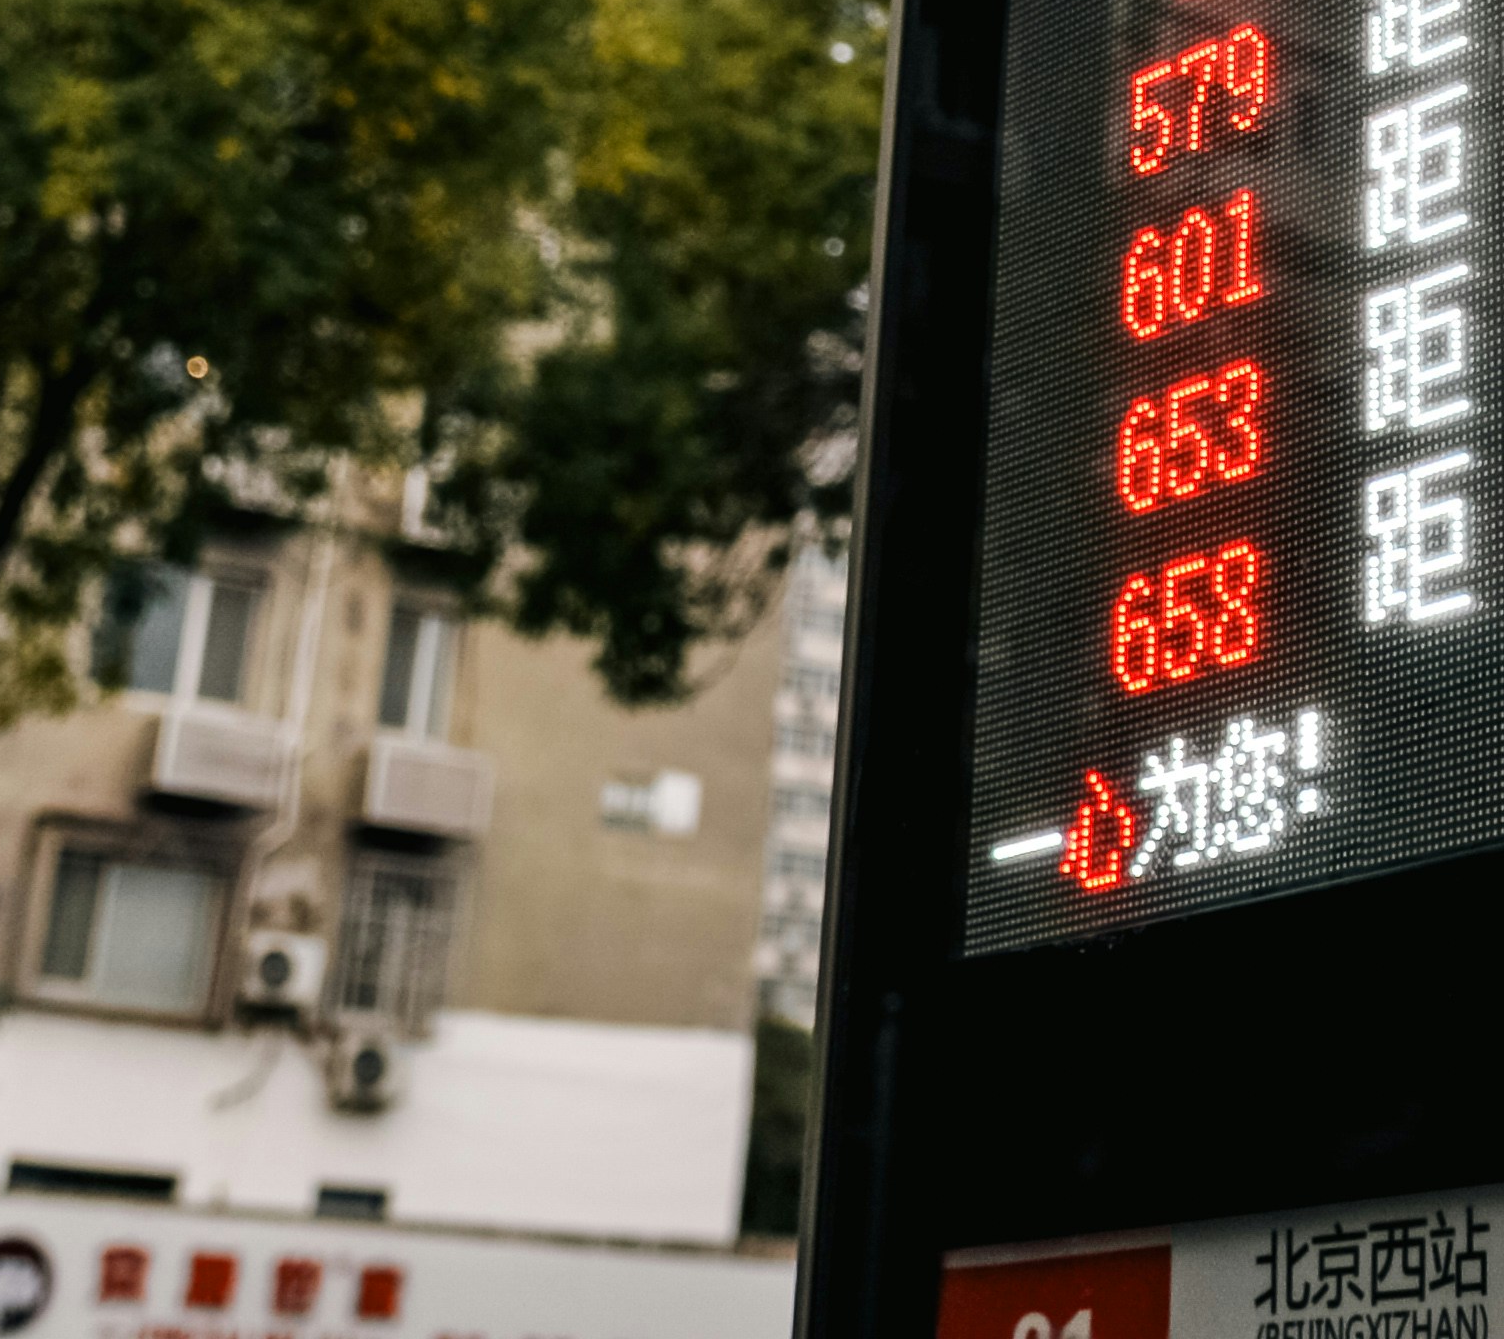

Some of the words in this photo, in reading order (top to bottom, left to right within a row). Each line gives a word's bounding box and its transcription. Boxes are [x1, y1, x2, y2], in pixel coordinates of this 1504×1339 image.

[1121, 188, 1263, 341] 601
[1366, 83, 1473, 252] 距
[1131, 23, 1269, 174] 579
[1119, 359, 1261, 513] 653
[1366, 263, 1474, 431] 距
[1114, 541, 1260, 694] 658
[1366, 451, 1476, 625] 距
[1253, 1205, 1491, 1316] 北京西站
